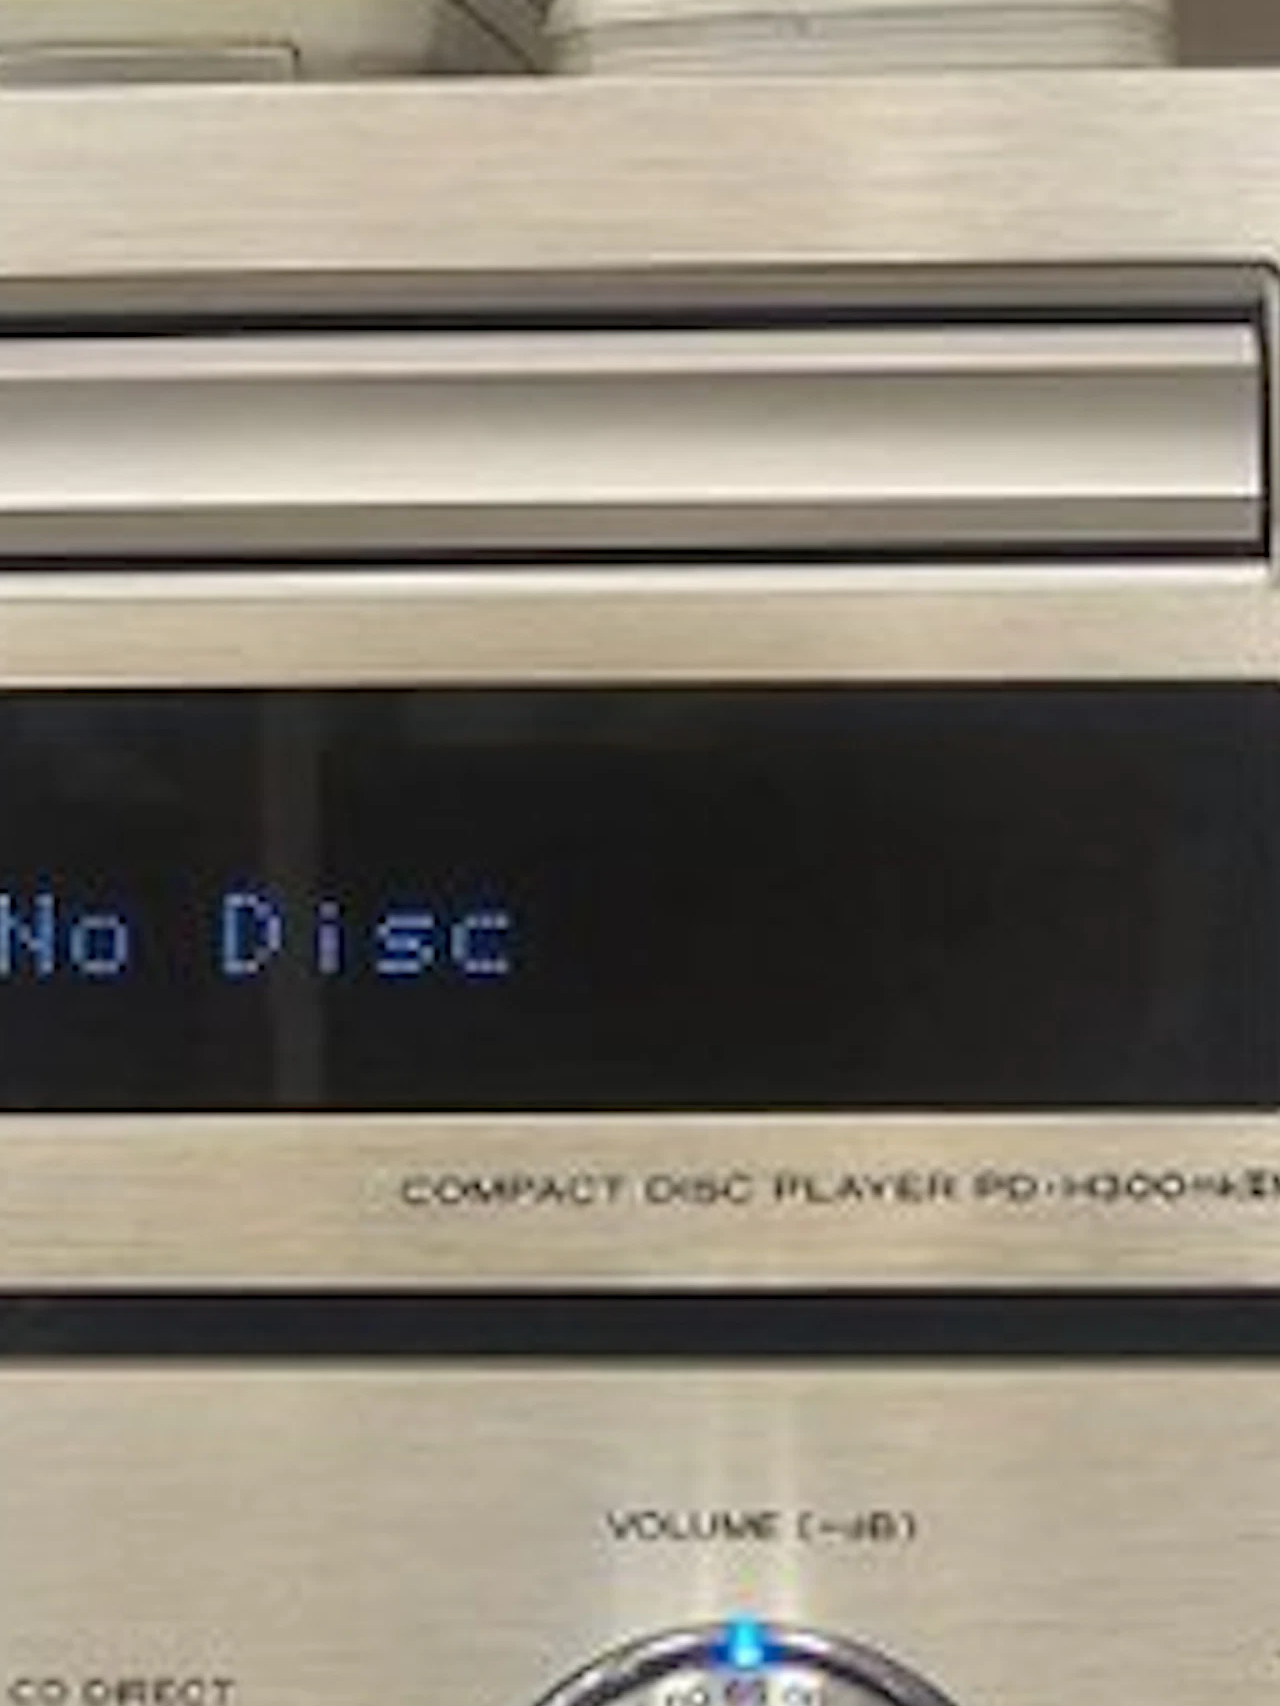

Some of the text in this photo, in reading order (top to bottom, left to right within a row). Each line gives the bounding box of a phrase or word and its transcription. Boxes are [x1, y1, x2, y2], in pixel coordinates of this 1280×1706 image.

[223, 892, 510, 975] Disc
[399, 1174, 624, 1206] COMPACT
[644, 1172, 753, 1205] DISC
[772, 1171, 957, 1204] PLAYER
[608, 1510, 780, 1542] VOLUME
